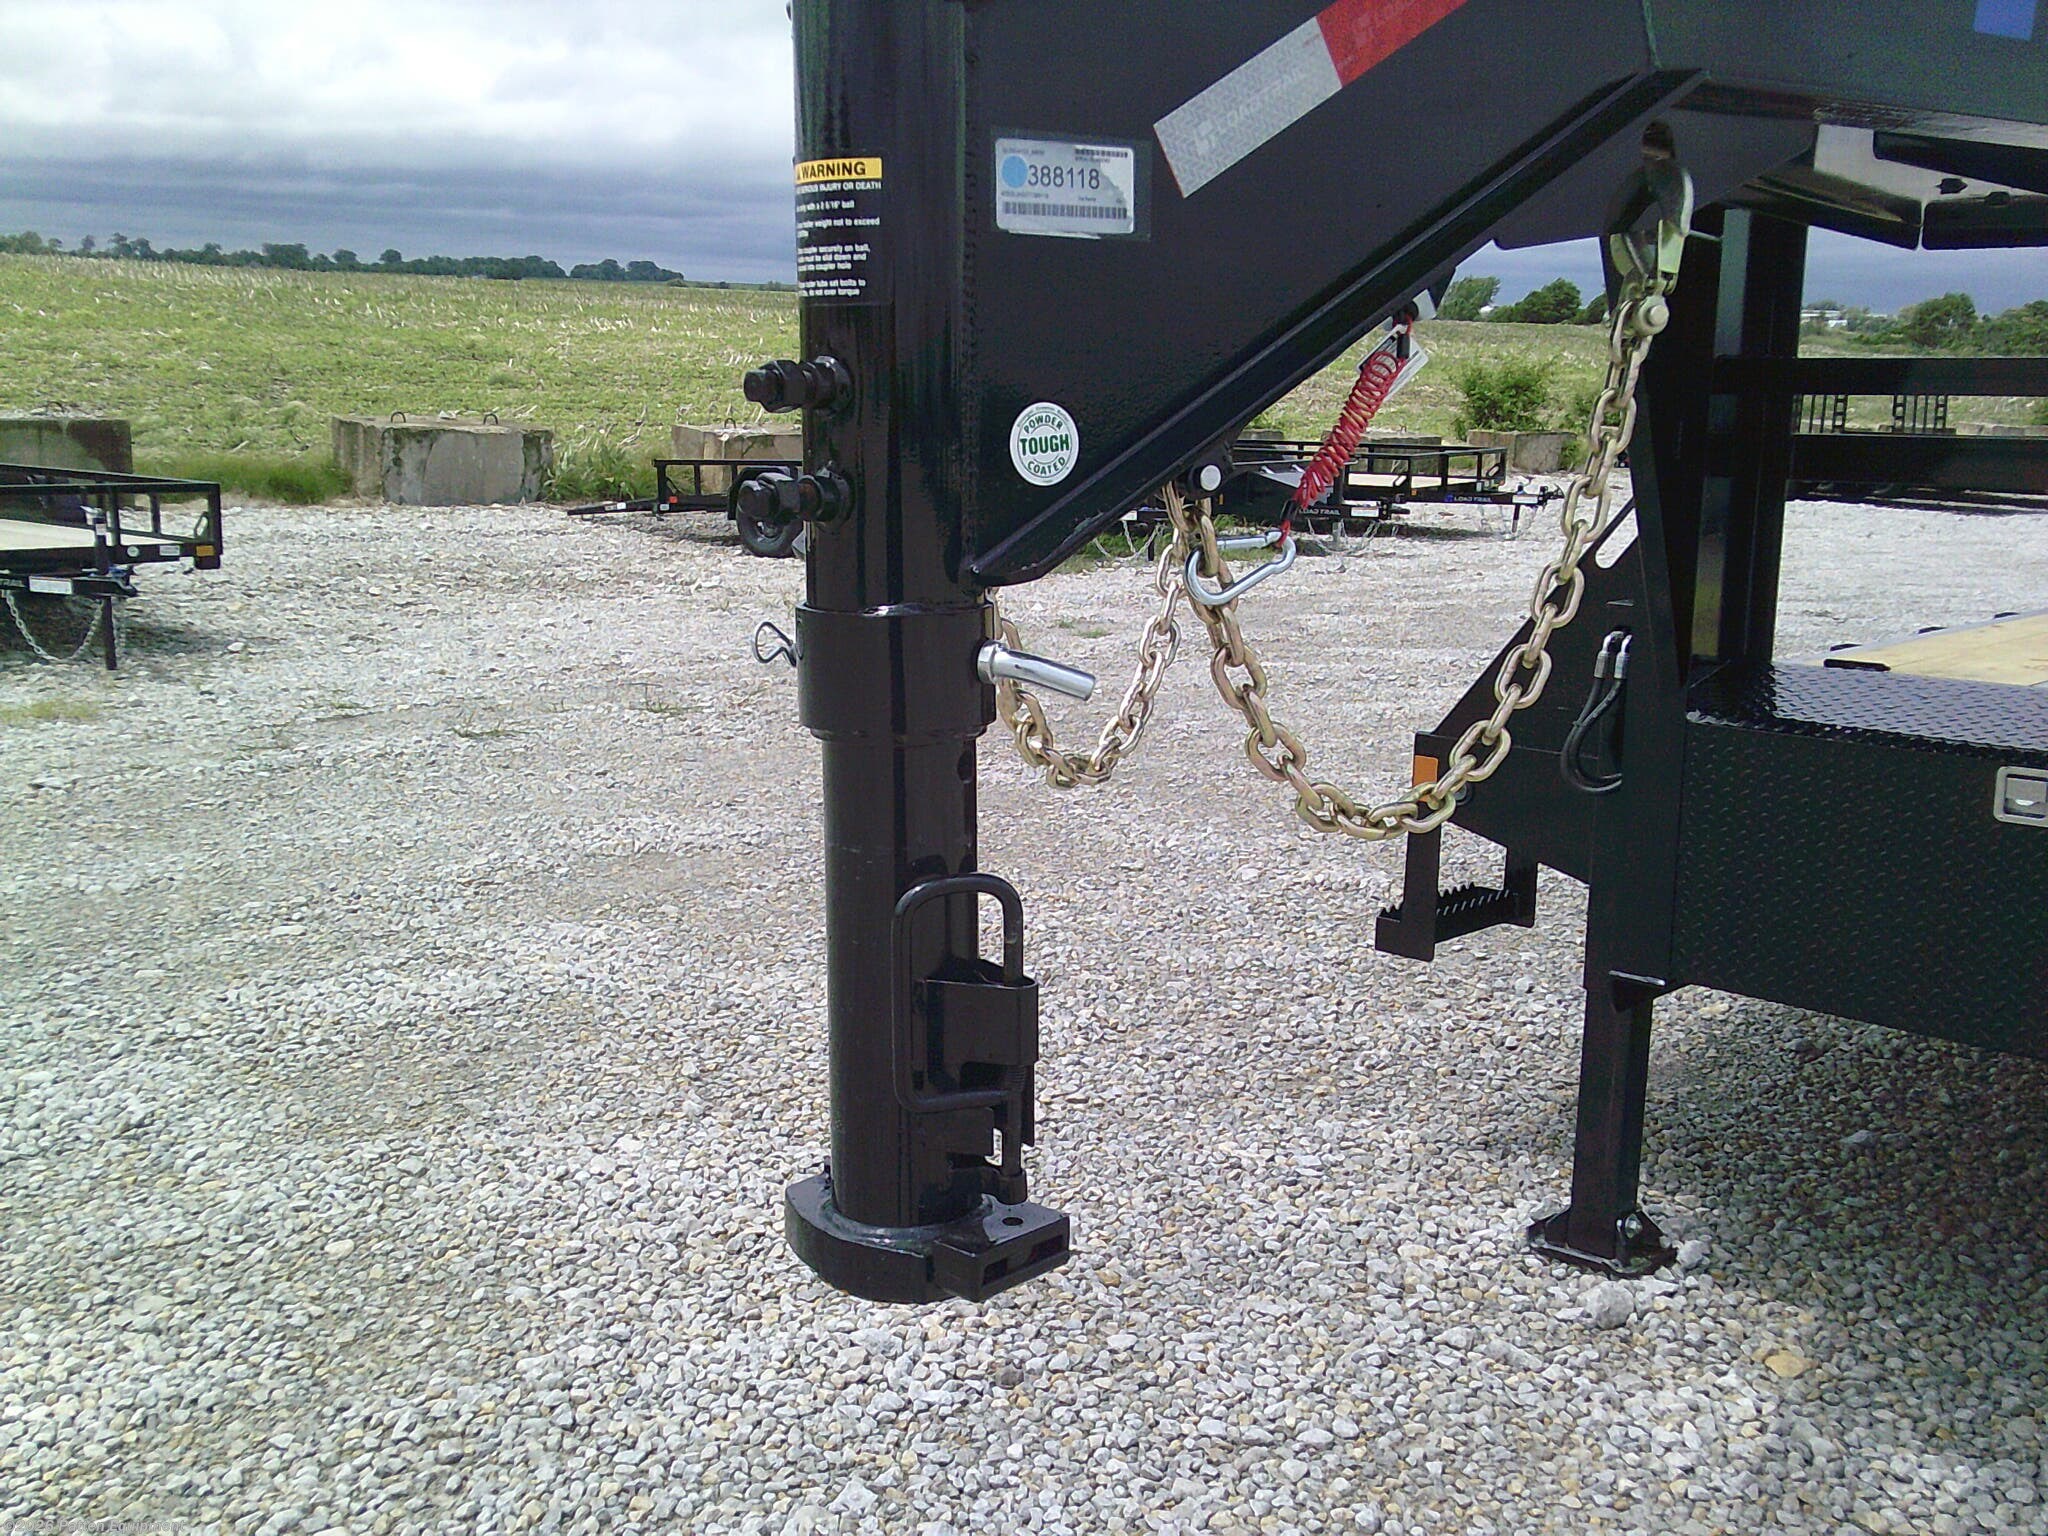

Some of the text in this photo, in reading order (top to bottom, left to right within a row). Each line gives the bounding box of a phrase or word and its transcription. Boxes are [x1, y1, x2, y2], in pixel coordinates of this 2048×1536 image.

[801, 161, 866, 179] WARNING
[1028, 164, 1100, 190] 388118
[843, 181, 853, 190] OR
[855, 181, 881, 190] DEATH
[1024, 414, 1064, 434] POWDER
[1019, 433, 1070, 456] TOUGH
[1027, 456, 1066, 475] COATED
